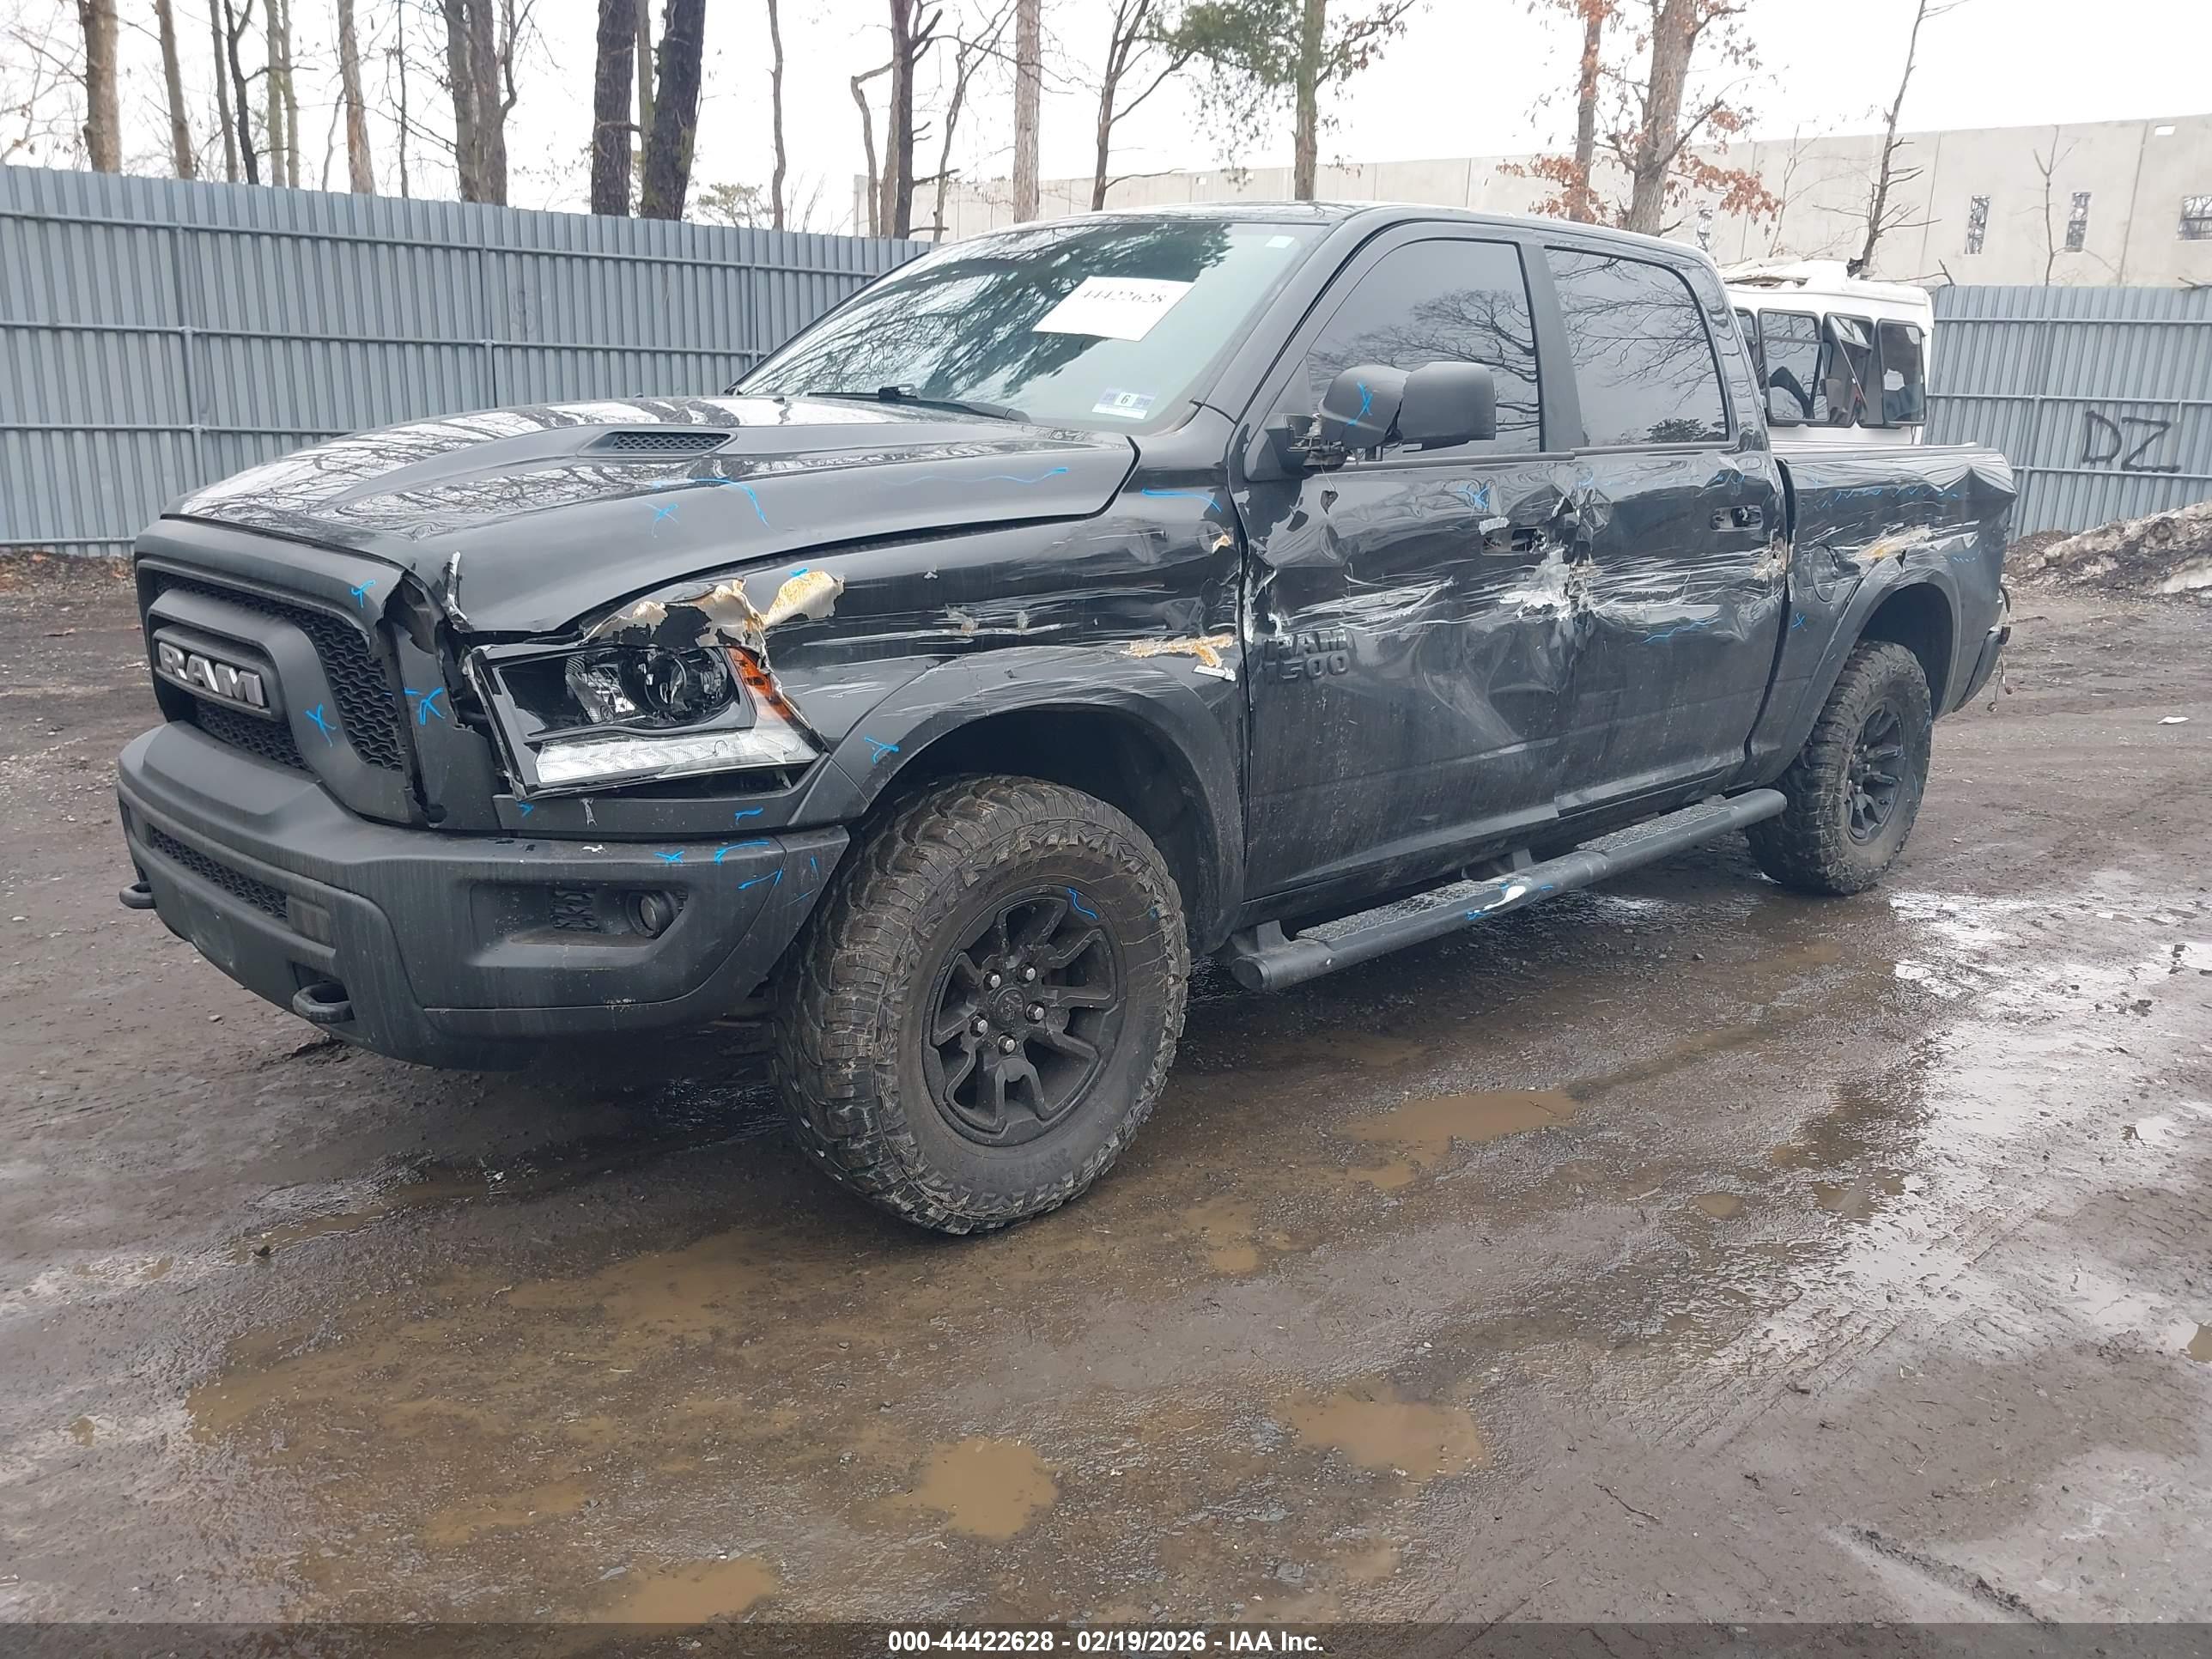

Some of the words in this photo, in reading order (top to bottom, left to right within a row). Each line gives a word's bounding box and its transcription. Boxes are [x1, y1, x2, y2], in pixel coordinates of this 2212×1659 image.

[1121, 394, 1131, 404] 6
[2082, 410, 2181, 472] DZ
[159, 641, 264, 707] RAM
